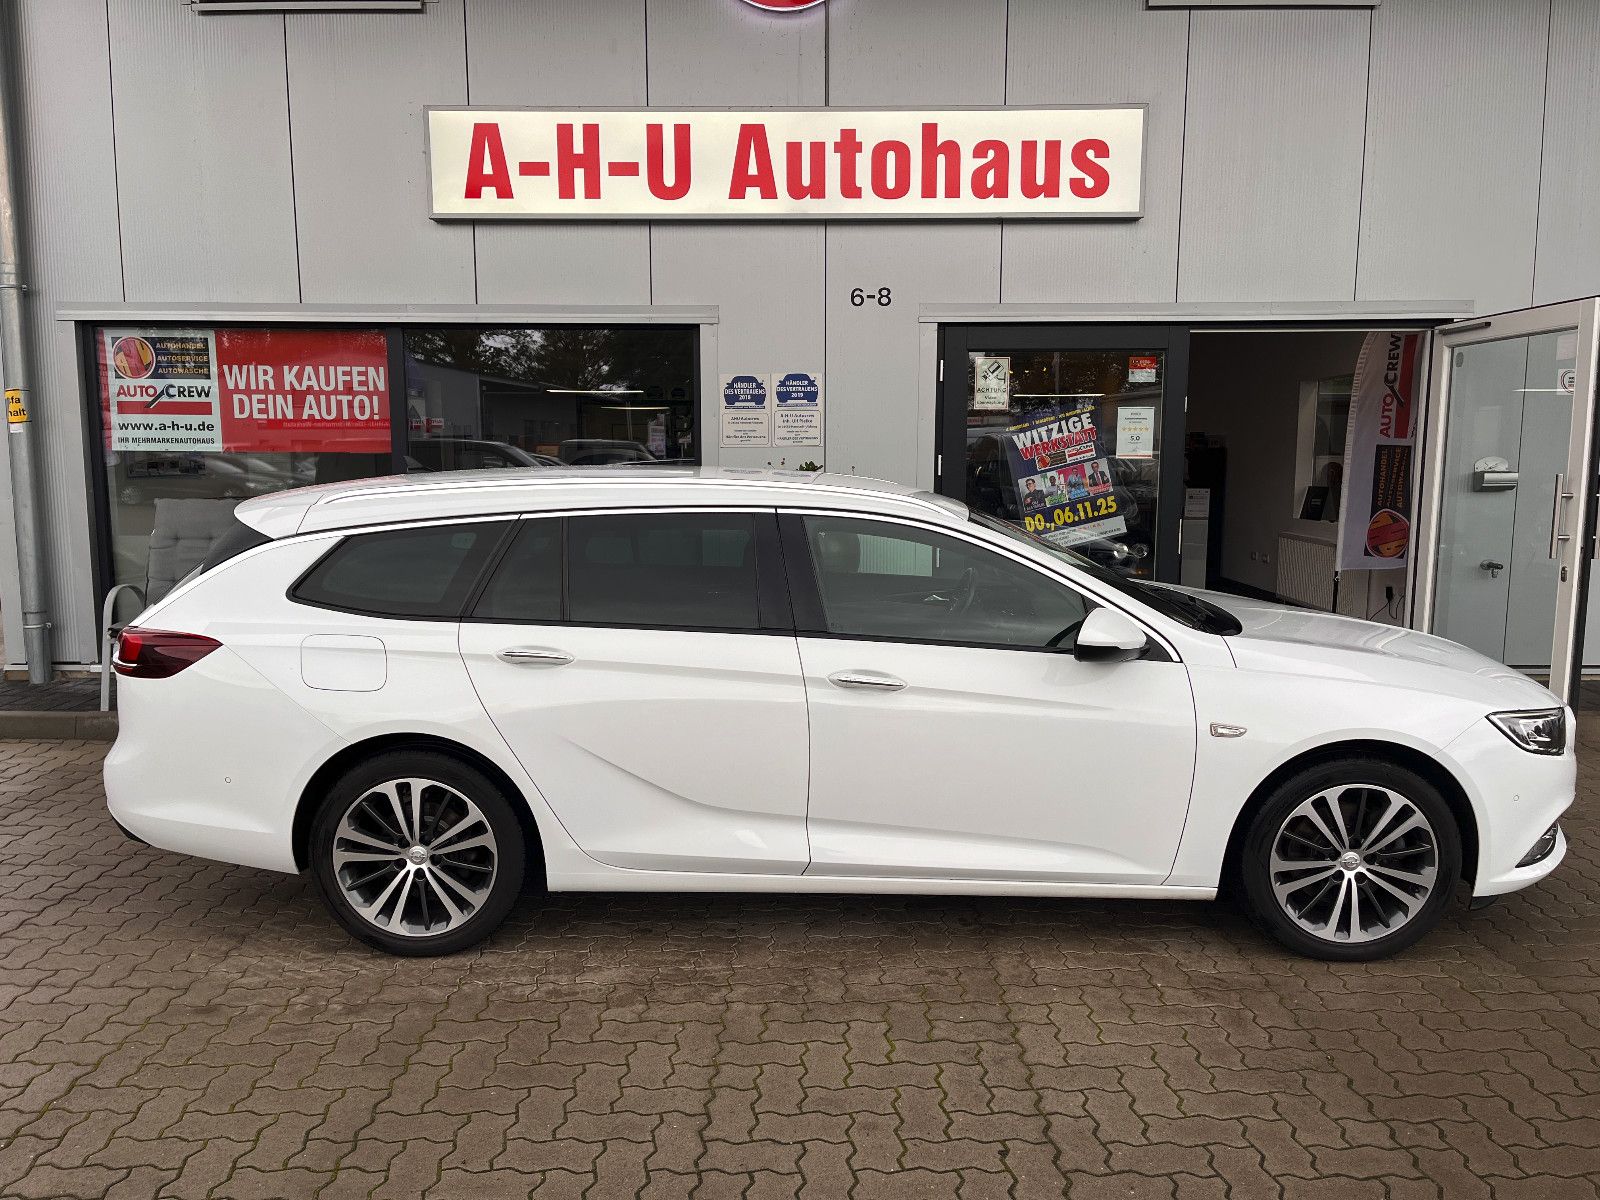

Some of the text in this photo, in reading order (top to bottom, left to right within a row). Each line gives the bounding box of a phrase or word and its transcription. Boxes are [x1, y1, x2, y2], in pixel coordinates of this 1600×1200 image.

[464, 123, 1111, 201] A-H-U Autohaus
[850, 286, 892, 307] 6-8
[117, 384, 212, 398] AUTO CREW
[223, 365, 386, 392] WIR KAUFEN
[1379, 332, 1401, 439] AUTO CREW
[232, 394, 380, 421] DEIN AUTO!
[118, 421, 215, 431] www.a-h-u.de
[1012, 412, 1095, 449] WITZIGE
[1020, 427, 1098, 460] WERKSTATT
[1377, 448, 1388, 506] AUTOHANDEL
